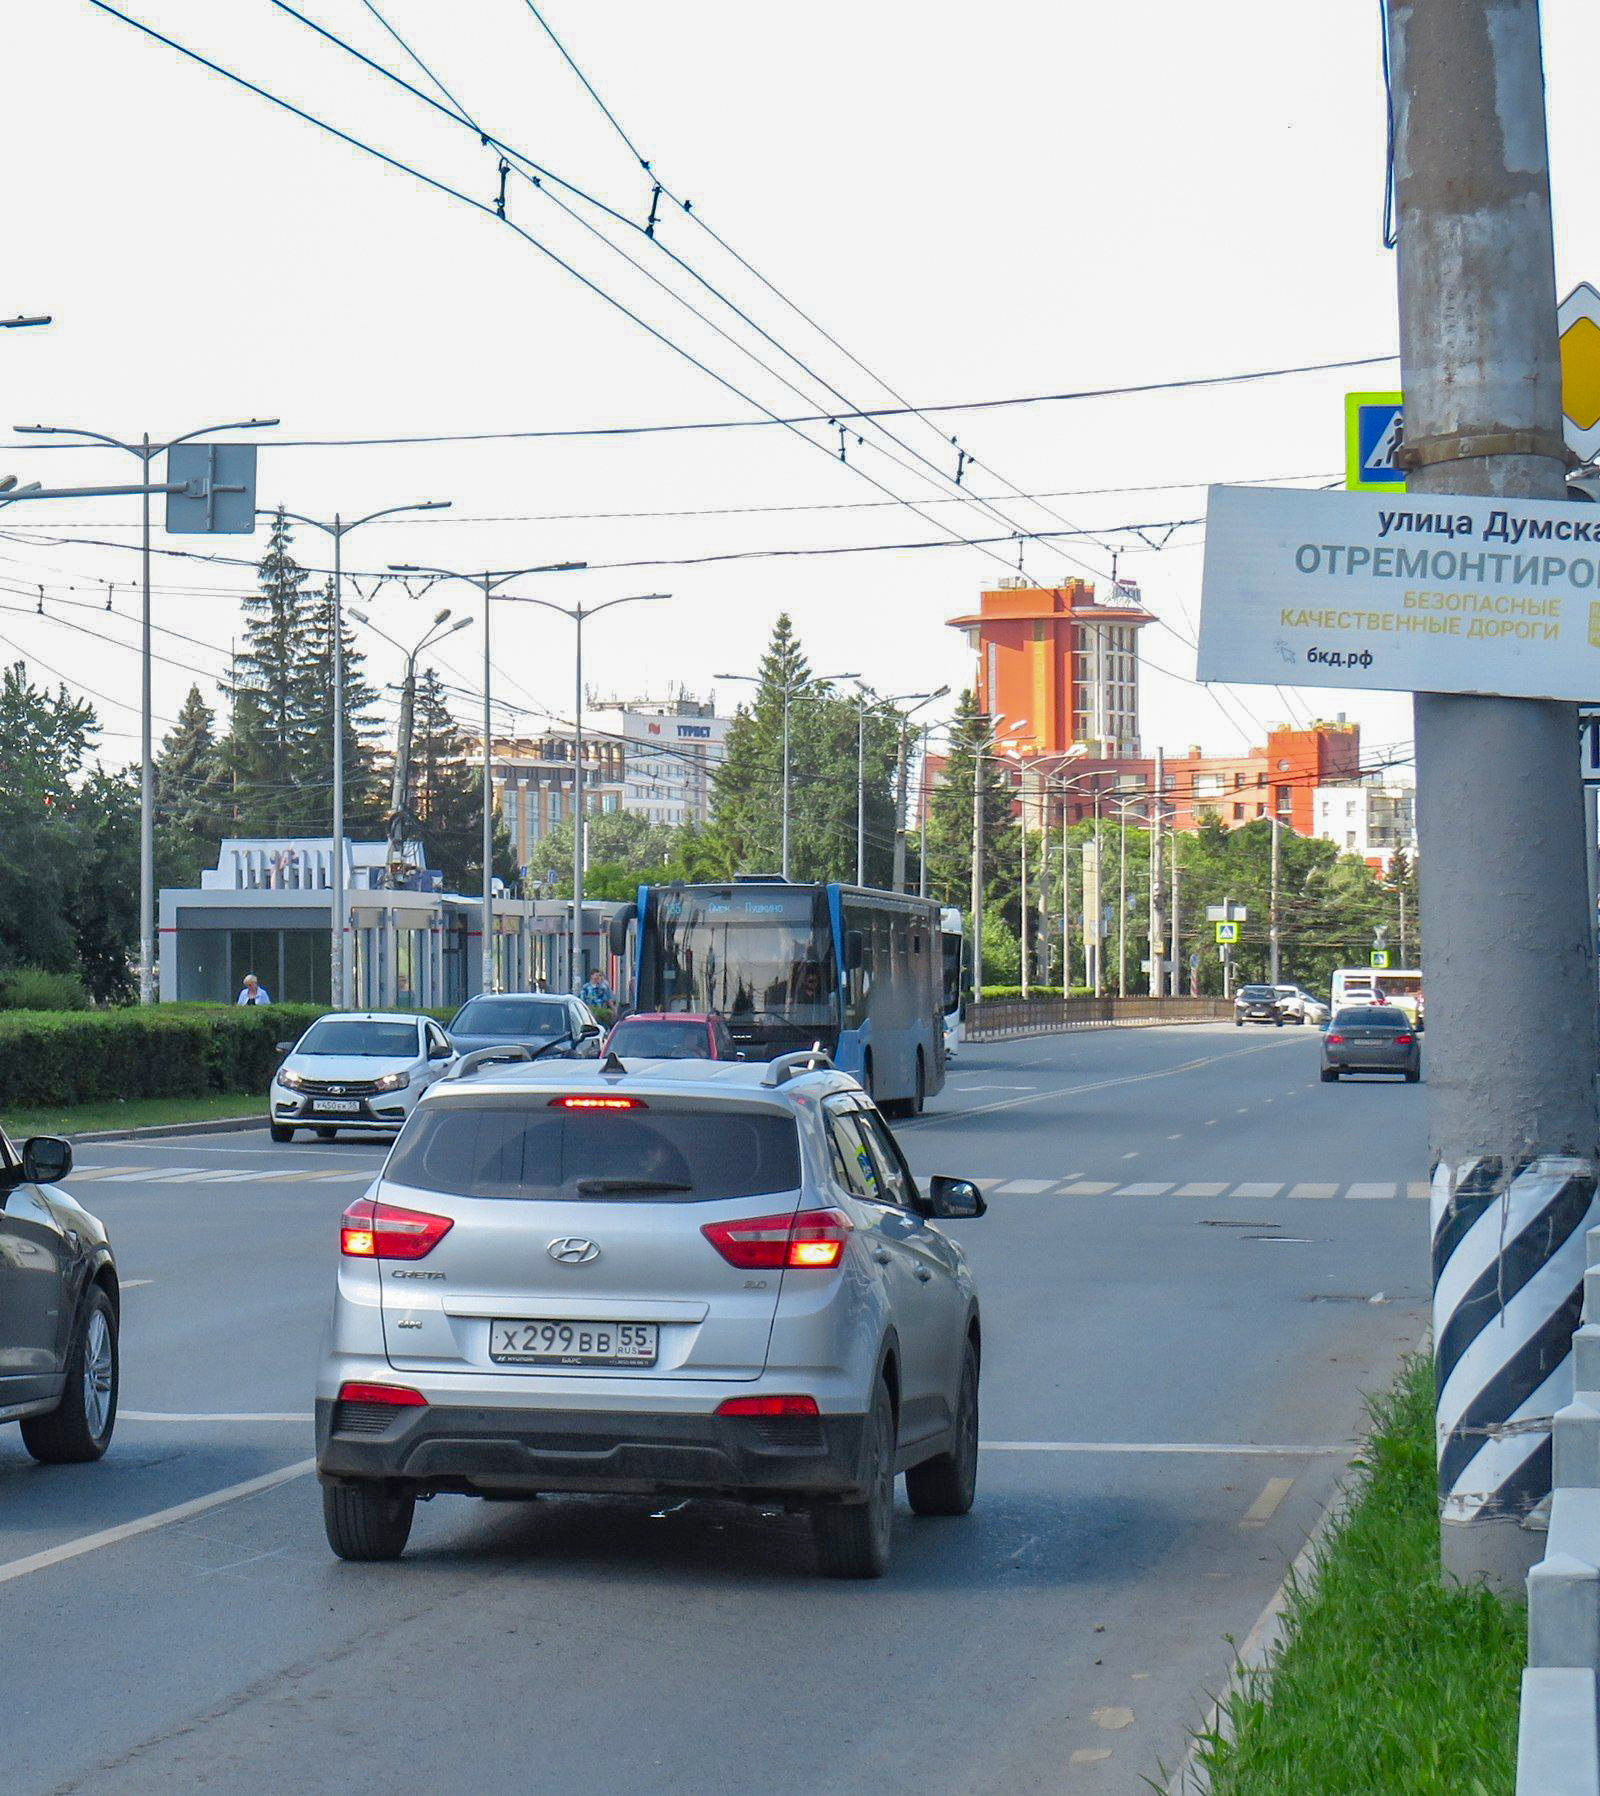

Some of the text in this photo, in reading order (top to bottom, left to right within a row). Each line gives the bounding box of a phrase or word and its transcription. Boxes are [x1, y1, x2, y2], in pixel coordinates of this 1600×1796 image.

[1377, 510, 1473, 538] улица
[1294, 544, 1600, 589] ОТРЕМОНТИРО
[1403, 591, 1562, 617] БЕЗОПАСНЫЕ
[1280, 608, 1560, 641] КАЧЕСТВЕННЫЕ ДОРОГИ
[1306, 646, 1373, 669] бкд.рф
[392, 1270, 447, 1281] CRETA
[503, 1325, 647, 1353] Х299ВВ 55
[617, 1346, 637, 1355] RUS
